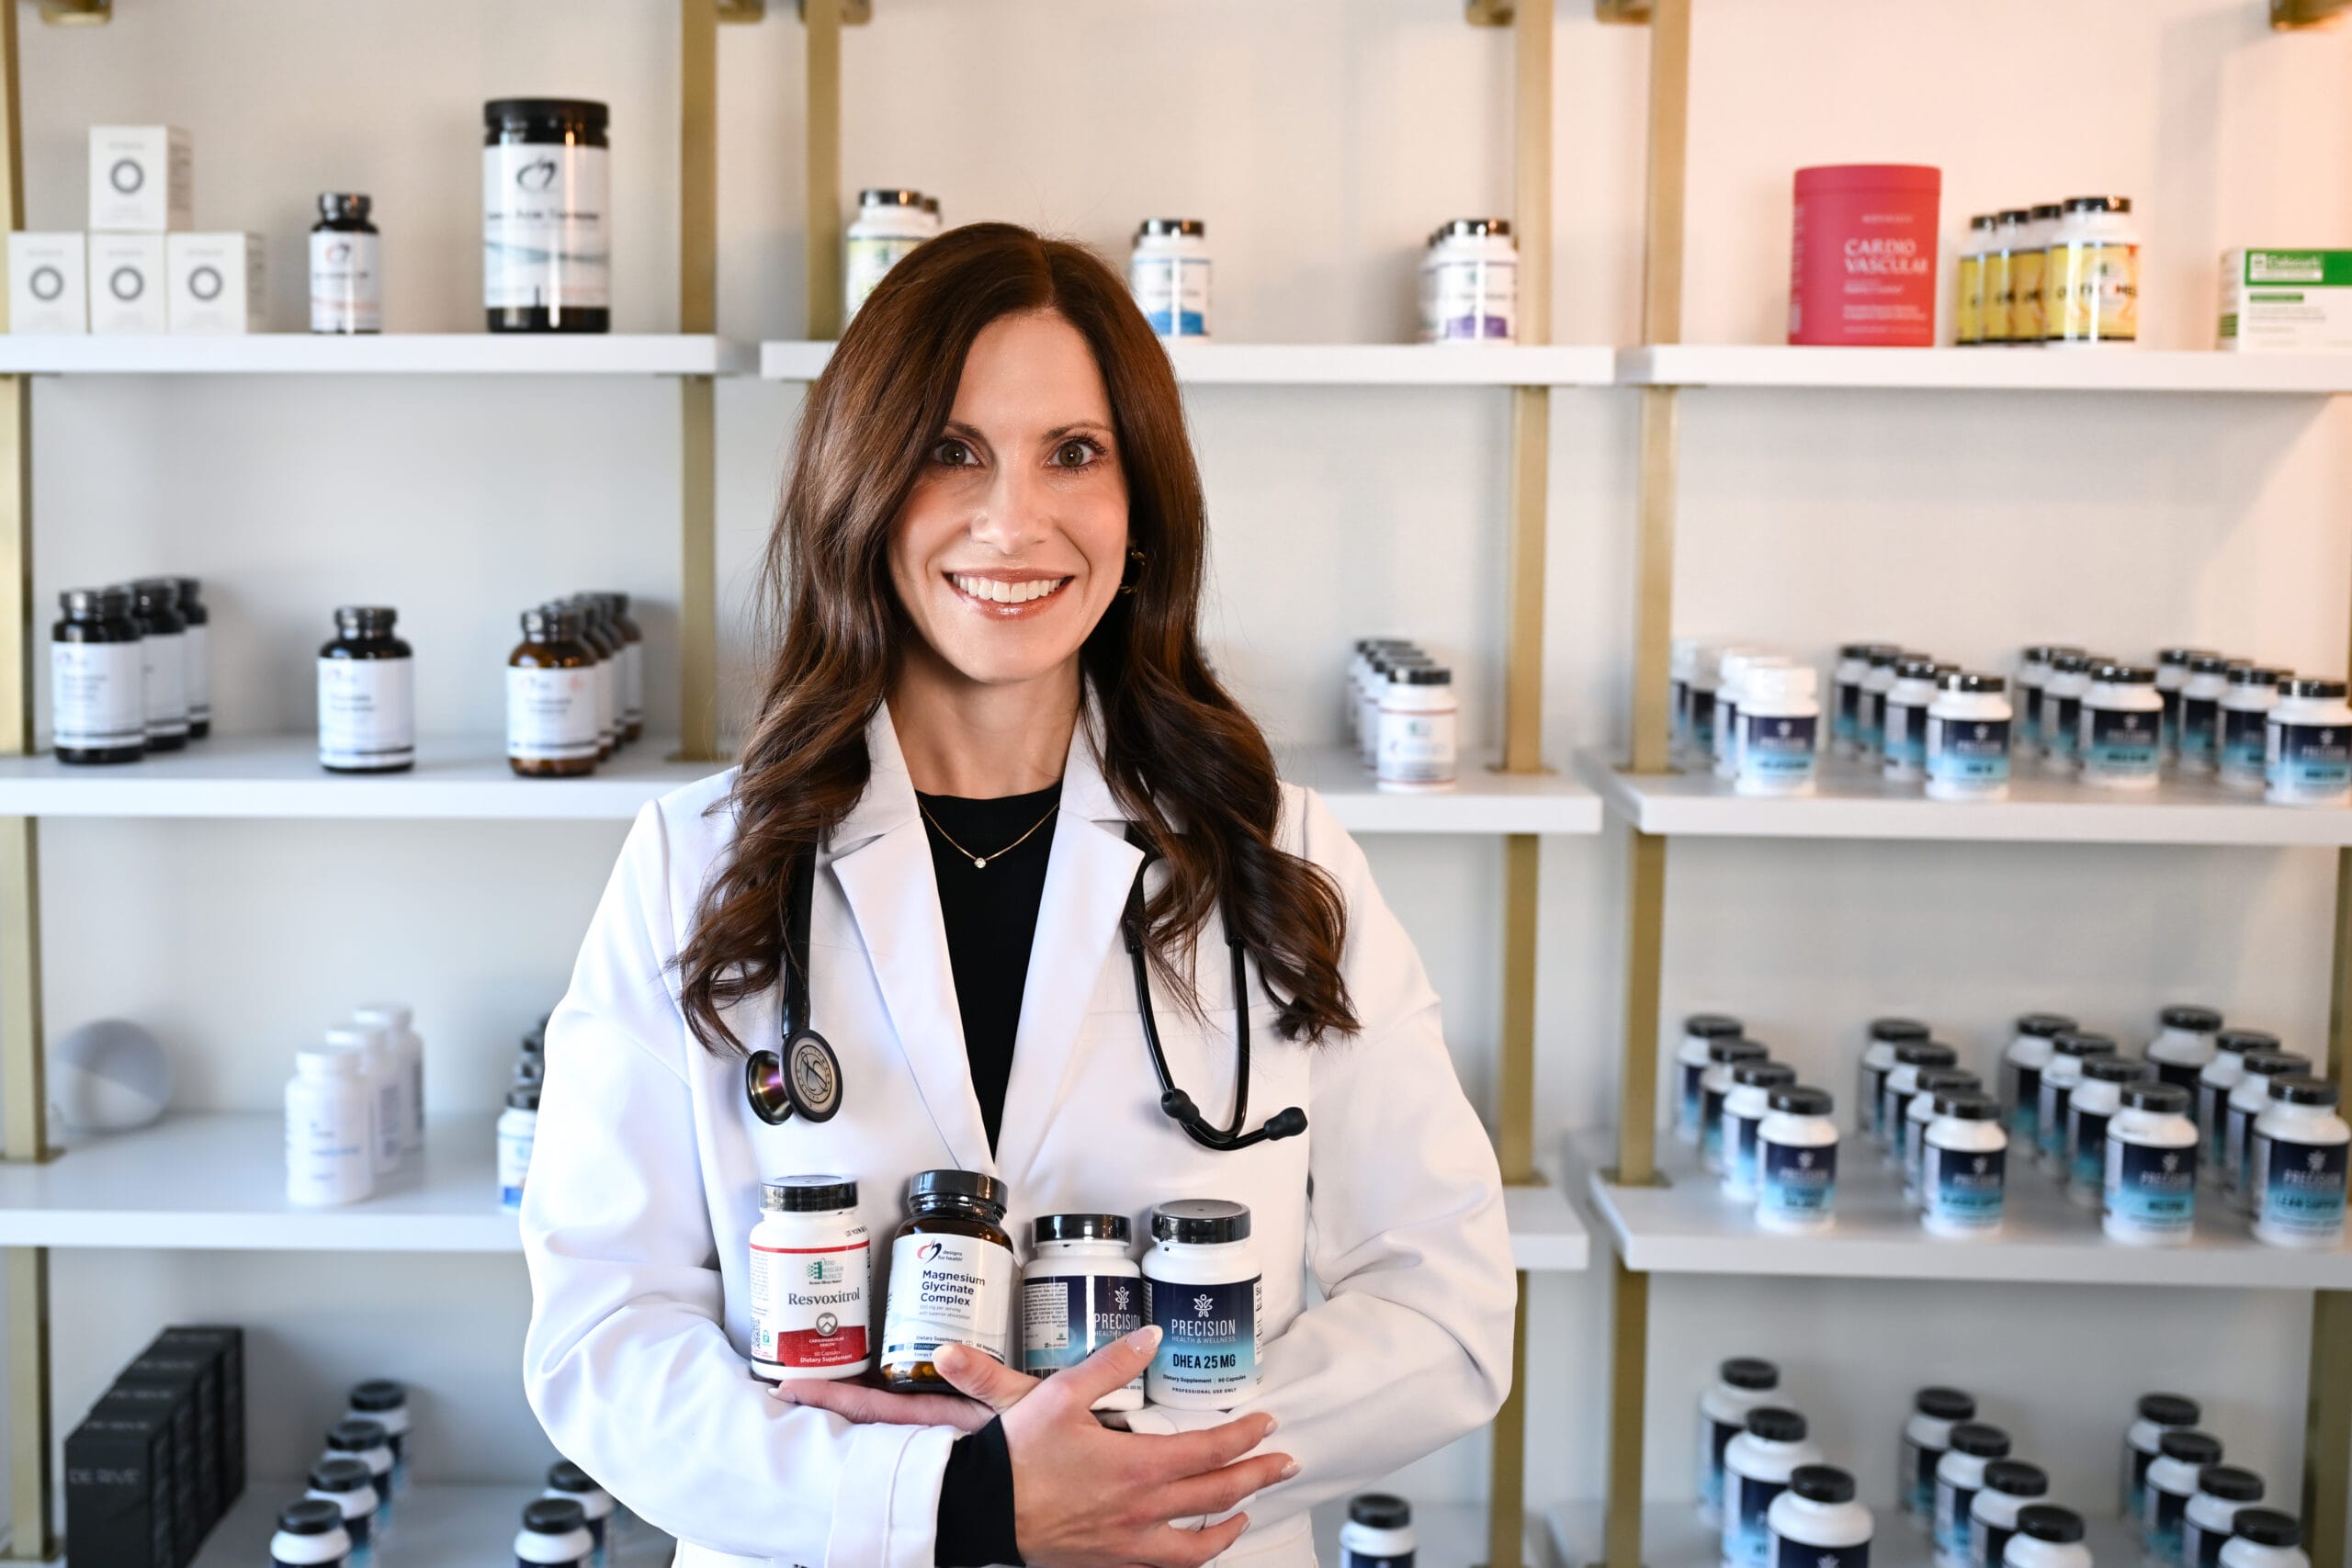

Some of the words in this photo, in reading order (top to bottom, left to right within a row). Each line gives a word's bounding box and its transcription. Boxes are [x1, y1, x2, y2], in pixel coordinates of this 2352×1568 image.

[1844, 238, 1917, 256] CARDIO
[1844, 257, 1928, 275] VASCULAR
[922, 1269, 986, 1286] Magnesium
[788, 1286, 860, 1305] Resvoxitrol
[922, 1281, 975, 1295] Glycinate
[921, 1292, 970, 1307] Complex
[1171, 1318, 1236, 1337] PRECISION
[1171, 1336, 1193, 1344] HEALTH
[1203, 1336, 1236, 1344] WELLNESS
[822, 1354, 853, 1363] Supplement
[1172, 1353, 1202, 1369] DHEA
[1204, 1355, 1218, 1369] 25
[1220, 1353, 1236, 1369] MG
[1162, 1373, 1180, 1382] Dietary
[1226, 1374, 1246, 1382] Capsules
